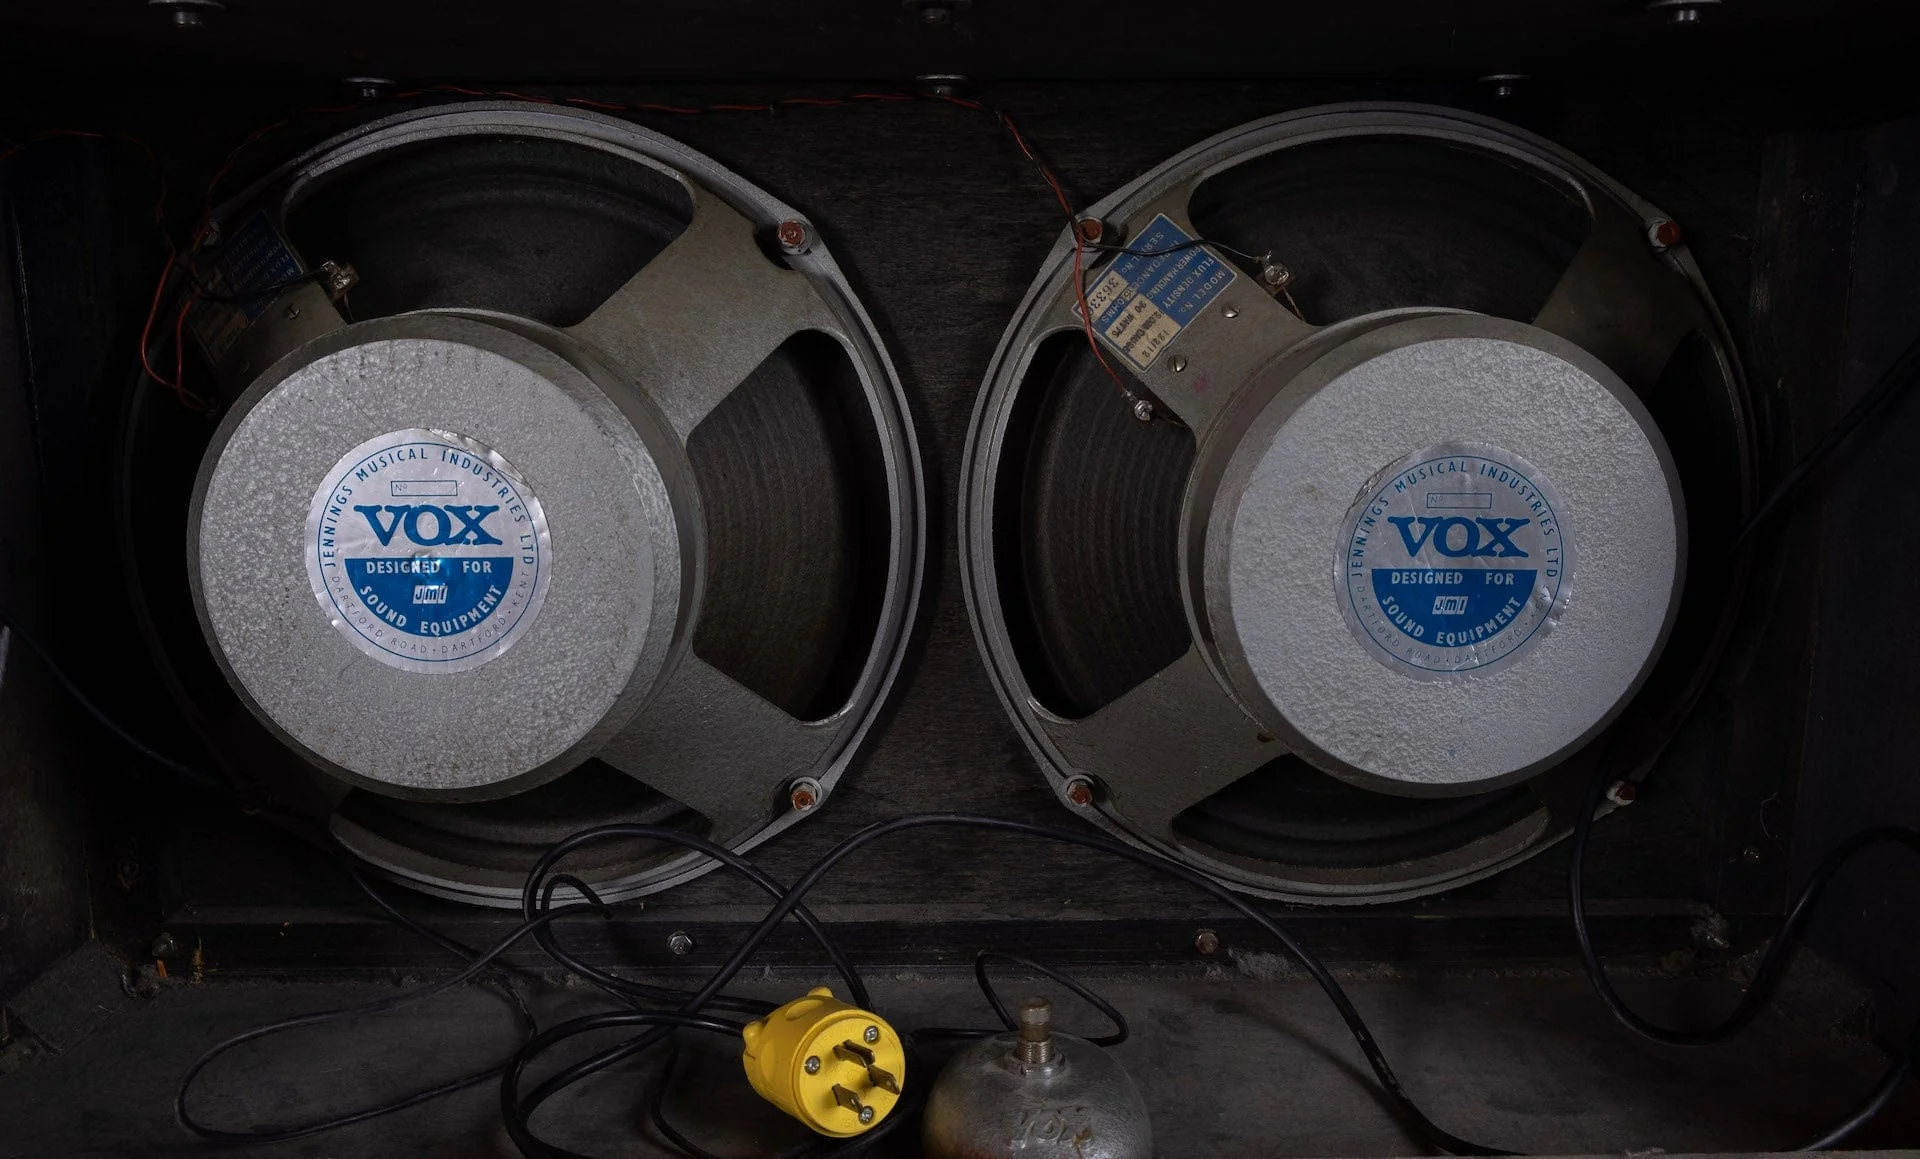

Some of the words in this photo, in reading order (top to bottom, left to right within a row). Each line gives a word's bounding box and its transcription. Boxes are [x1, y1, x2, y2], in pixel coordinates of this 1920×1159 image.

[1174, 244, 1201, 271] POWER
[1191, 256, 1214, 279] FLUX
[1144, 265, 1179, 300] HANDLING
[1160, 275, 1194, 309] DENSITY
[1191, 268, 1225, 302] MODEL
[1099, 296, 1125, 325] OHMS
[323, 485, 352, 568] JENNINGS
[355, 448, 428, 482] MUSICAL
[441, 450, 526, 523] INDUSTRIES
[520, 535, 535, 565] LTD
[353, 504, 503, 546] VOX
[1351, 497, 1390, 577] JENNINGS
[1394, 461, 1467, 493] MUSICAL
[1480, 464, 1555, 536] INDUSTRIES
[1545, 548, 1561, 578] LTD
[1387, 516, 1530, 558] VOX
[366, 560, 441, 574] DESIGNED
[463, 561, 492, 574] FOR
[1391, 572, 1463, 584] DESIGNED
[1485, 572, 1514, 585] FOR
[331, 576, 383, 638] DARTFORD
[390, 637, 427, 654] ROAD
[441, 617, 506, 654] DARTFORD
[512, 572, 530, 608] KENT
[360, 586, 407, 628] SOUND
[420, 586, 502, 636] EQUIPMENT
[1382, 595, 1424, 638] SOUND
[1436, 596, 1521, 645] EQUIPMENT
